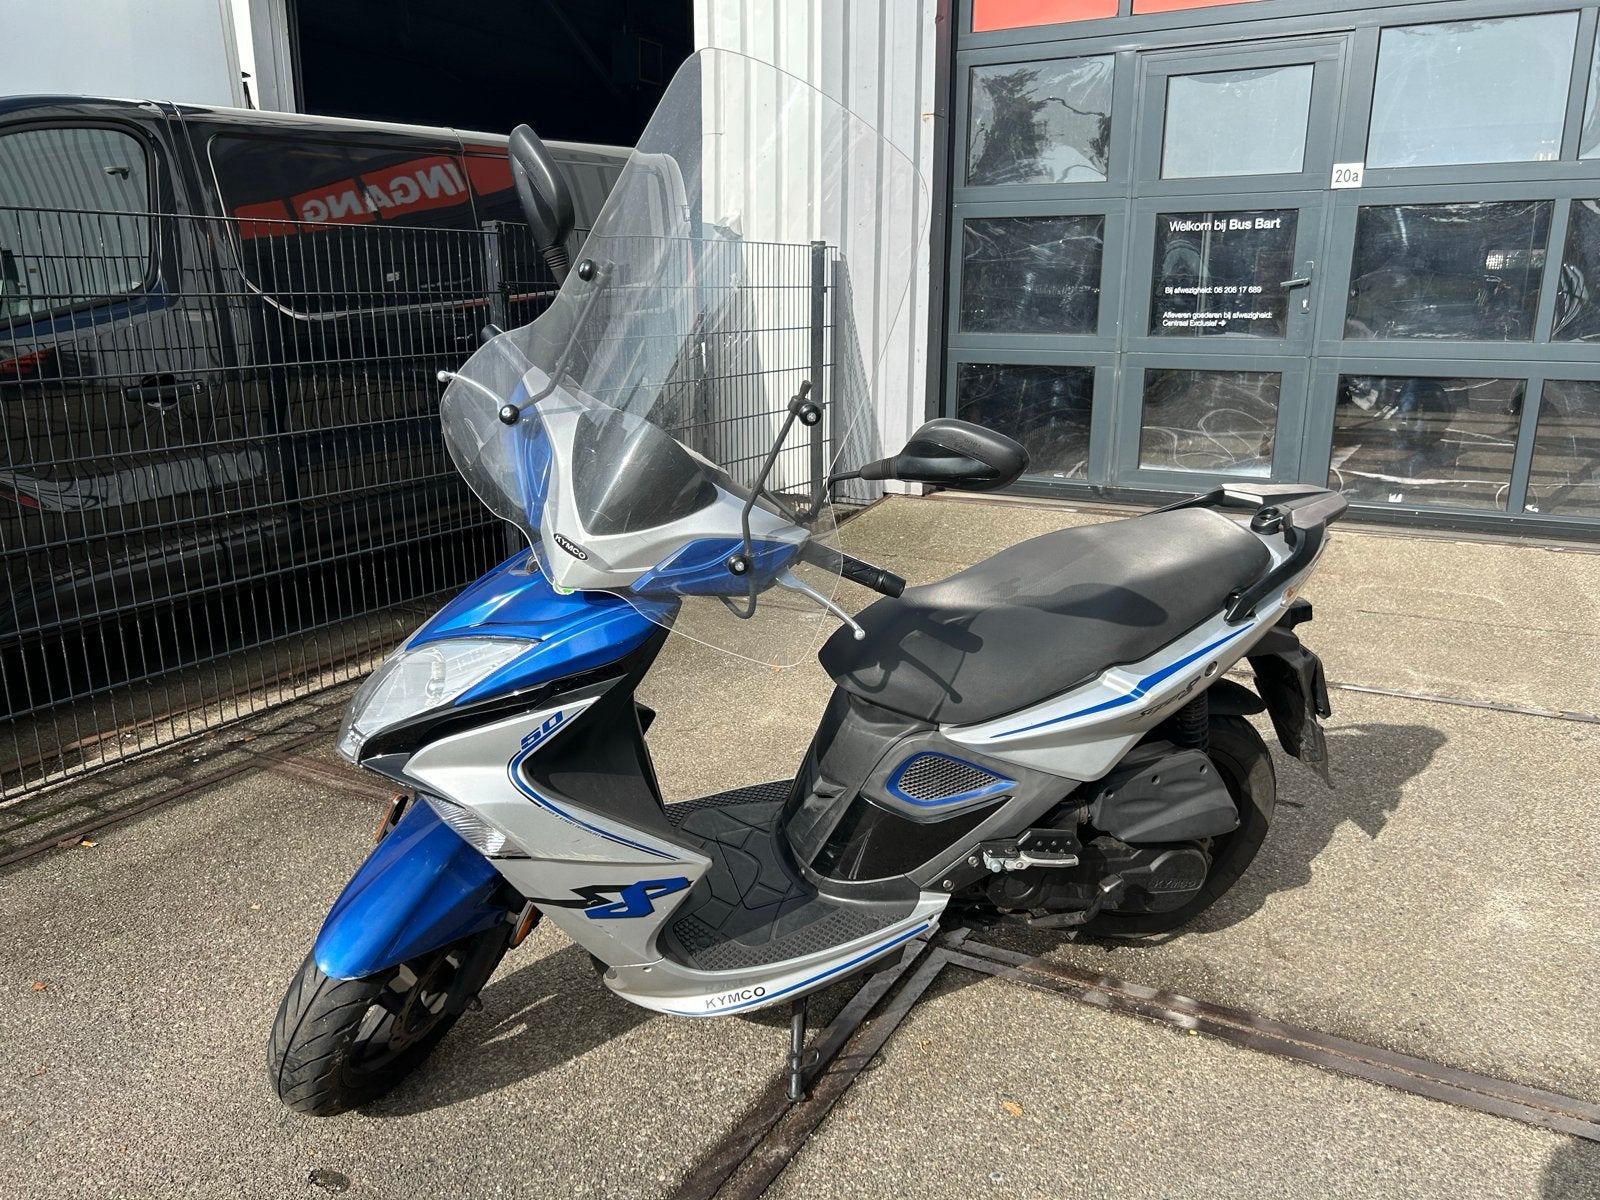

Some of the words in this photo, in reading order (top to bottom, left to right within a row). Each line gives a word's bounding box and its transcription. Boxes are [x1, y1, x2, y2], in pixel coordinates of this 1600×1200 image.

[1335, 169, 1359, 183] 20a
[1169, 220, 1212, 232] Welkom
[1213, 219, 1227, 232] bij
[1229, 219, 1252, 230] Bus
[1254, 217, 1281, 229] Bart
[1164, 286, 1173, 295] Bij
[1174, 286, 1213, 295] afwezigheid:
[1213, 286, 1223, 294] 06
[1238, 286, 1247, 294] 17
[1162, 311, 1192, 319] Afleveren
[1192, 311, 1222, 320] goederen
[1223, 311, 1232, 320] bij
[1232, 311, 1273, 320] afwezigheid:
[1189, 319, 1218, 327] Exclusief
[555, 534, 586, 560] KYMCO
[520, 710, 564, 750] 50
[705, 986, 766, 1009] KYMCO
